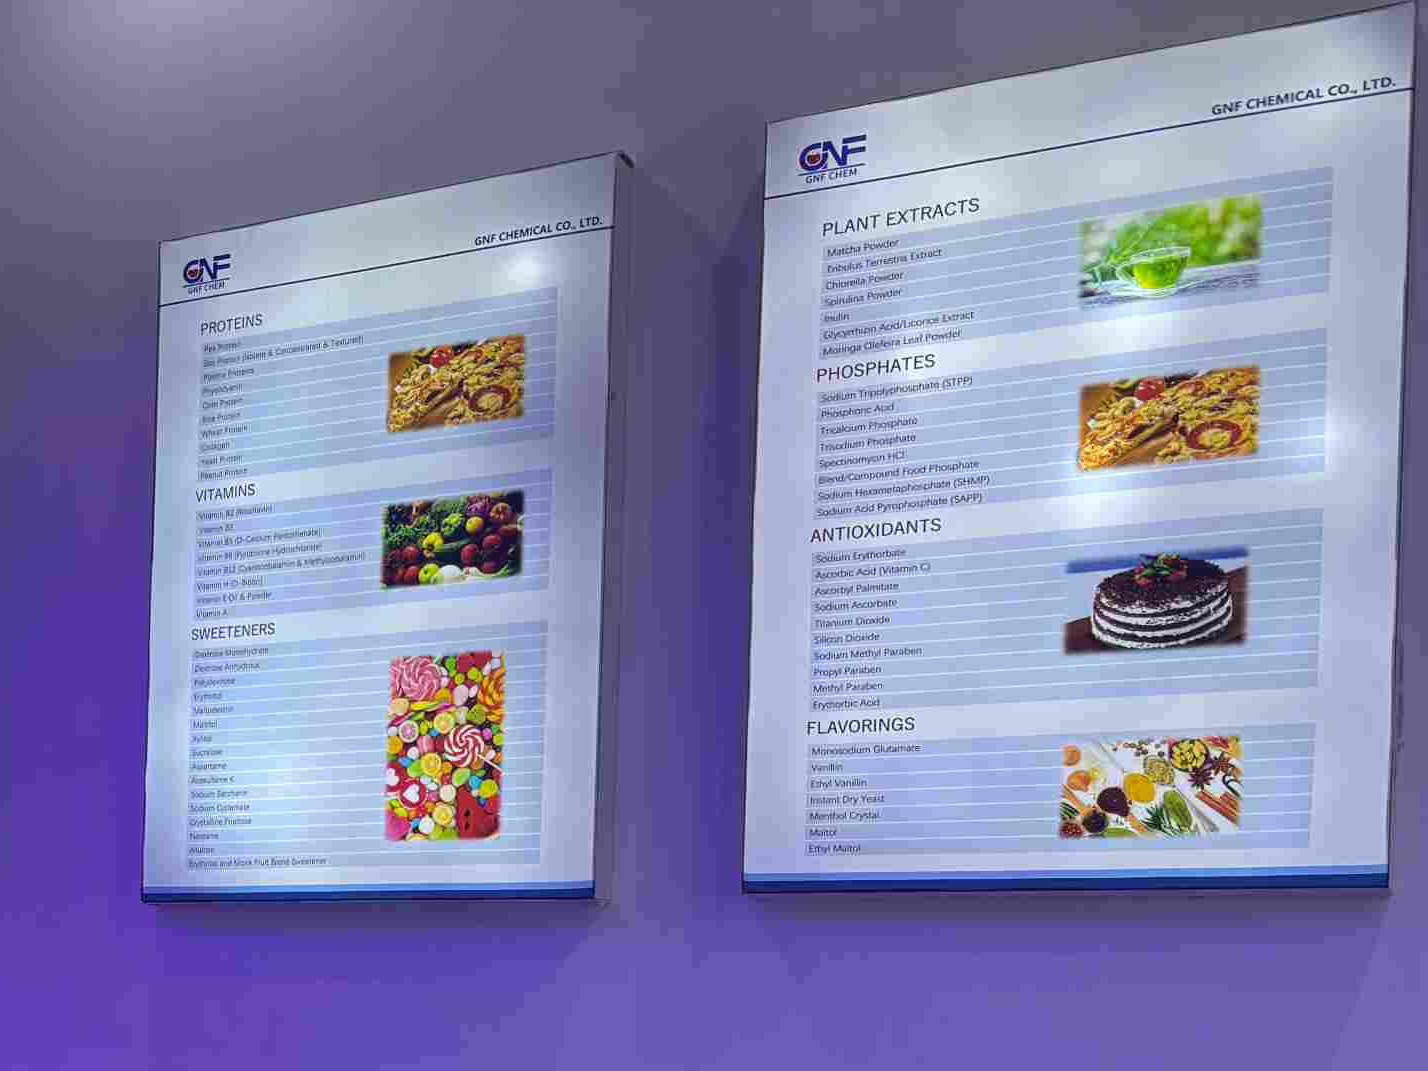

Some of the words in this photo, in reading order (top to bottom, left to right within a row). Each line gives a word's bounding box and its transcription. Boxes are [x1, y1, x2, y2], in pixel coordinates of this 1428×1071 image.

[1211, 100, 1242, 116] GNF
[1246, 86, 1324, 110] CHEMICAL
[1327, 82, 1358, 97] CO.,
[1362, 76, 1396, 91] LTD.
[805, 172, 824, 184] GNF
[828, 167, 858, 180] CHEM
[822, 213, 880, 237] PLANT
[885, 198, 980, 227] EXTRACTS
[474, 232, 498, 247] GNF
[499, 223, 552, 242] CHEMICAL
[579, 217, 603, 228] LTD.
[827, 244, 860, 257] Matcha
[863, 238, 899, 251] Powder
[909, 247, 942, 261] Extract
[868, 270, 903, 284] Powder
[866, 287, 901, 300] Powder
[200, 312, 262, 335] PROTEINS
[942, 311, 974, 324] Extract
[902, 334, 922, 345] Leaf
[925, 329, 961, 342] Powder
[815, 353, 936, 382] PHOSPHATES
[820, 390, 856, 402] Sodium
[941, 376, 972, 390] (STPP)
[873, 402, 894, 413] Acid
[868, 416, 917, 432] Phosphate
[867, 433, 916, 448] Phosphate
[902, 465, 926, 476] Food
[928, 460, 980, 475] Phosphate
[195, 482, 256, 502] VITAMINS
[817, 488, 853, 500] Sodium
[953, 475, 990, 489] (SHMP)
[817, 504, 852, 516] Sodium
[854, 502, 874, 512] Acid
[949, 492, 982, 505] (SAPP)
[809, 517, 941, 542] ANTIOXIDANTS
[815, 552, 850, 563] Sodium
[815, 568, 854, 579] Ascorbic
[855, 566, 876, 576] Acid
[878, 563, 918, 576] (Vitamin
[814, 584, 853, 597] Ascorbyl
[855, 581, 899, 593] Palmitate
[814, 601, 849, 612] Sodium
[851, 598, 898, 609] Ascorbate
[814, 617, 853, 628] Titanium
[855, 615, 890, 625] Dioxide
[191, 621, 275, 641] SWEETENERS
[813, 634, 843, 644] Silicon
[844, 632, 880, 642] Dioxide
[813, 650, 848, 661] Sodium
[850, 648, 881, 660] Methyl
[883, 646, 922, 657] Paraben
[813, 666, 842, 678] Propyl
[844, 664, 882, 675] Paraben
[812, 683, 843, 695] Methyl
[845, 681, 883, 691] Paraben
[859, 698, 880, 707] Acid
[806, 717, 915, 735] FLAVORINGS
[811, 745, 870, 756] Monosodium
[873, 744, 920, 754] Glutamate
[810, 762, 843, 772] Vanillin
[809, 779, 832, 790] Ethyl
[834, 778, 867, 787] Vanillin
[809, 795, 839, 804] Instant
[842, 795, 859, 805] Dry
[860, 794, 884, 803] Yeast
[809, 812, 846, 821] Menthol
[849, 811, 878, 822] Crystal
[807, 844, 831, 854] Ethyl
